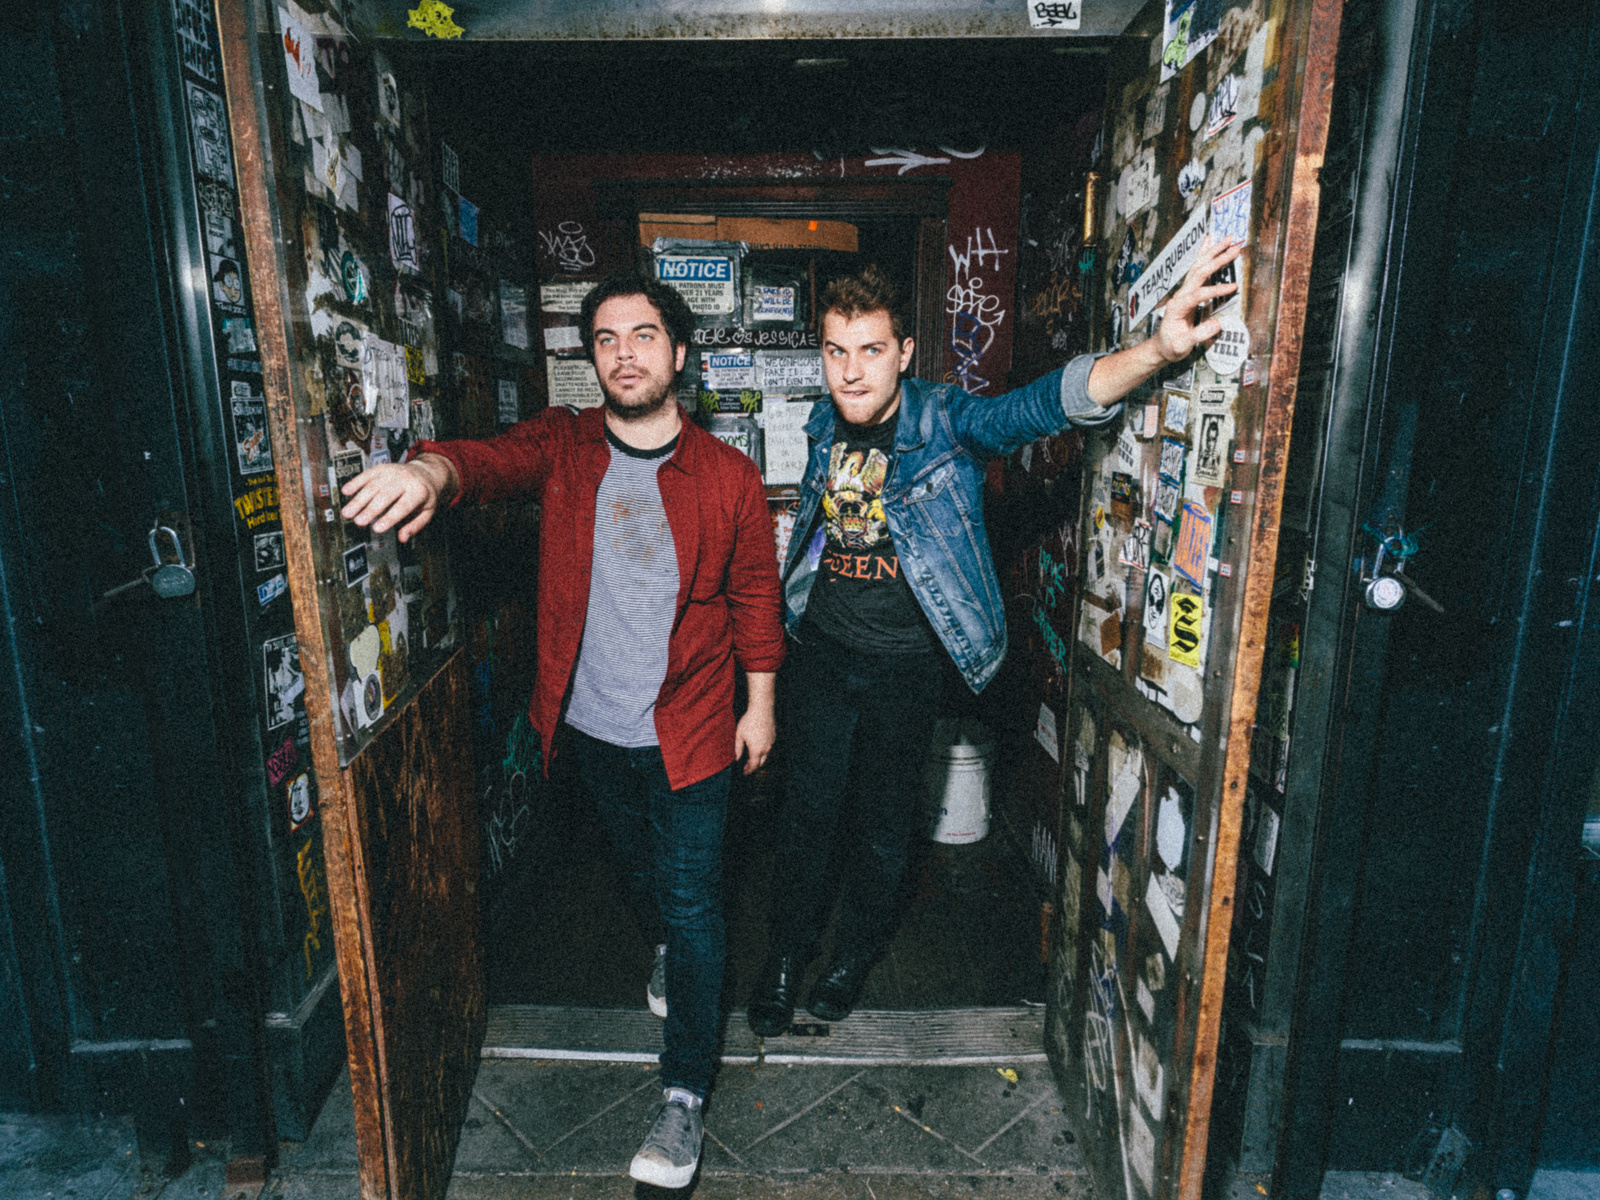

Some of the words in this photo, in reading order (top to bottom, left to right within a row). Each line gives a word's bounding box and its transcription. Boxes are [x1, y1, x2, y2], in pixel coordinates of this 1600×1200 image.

[1141, 267, 1166, 300] TEAM
[1165, 217, 1206, 274] RUBICON
[662, 262, 727, 278] NOTICE
[763, 297, 782, 305] WILL
[782, 297, 793, 305] BE
[1213, 343, 1239, 357] YELL
[712, 355, 750, 367] NOTICE
[765, 358, 778, 367] WE
[764, 368, 785, 376] FAKE
[764, 377, 784, 386] DON'T
[786, 377, 803, 386] EVEN
[804, 377, 817, 385] TRY
